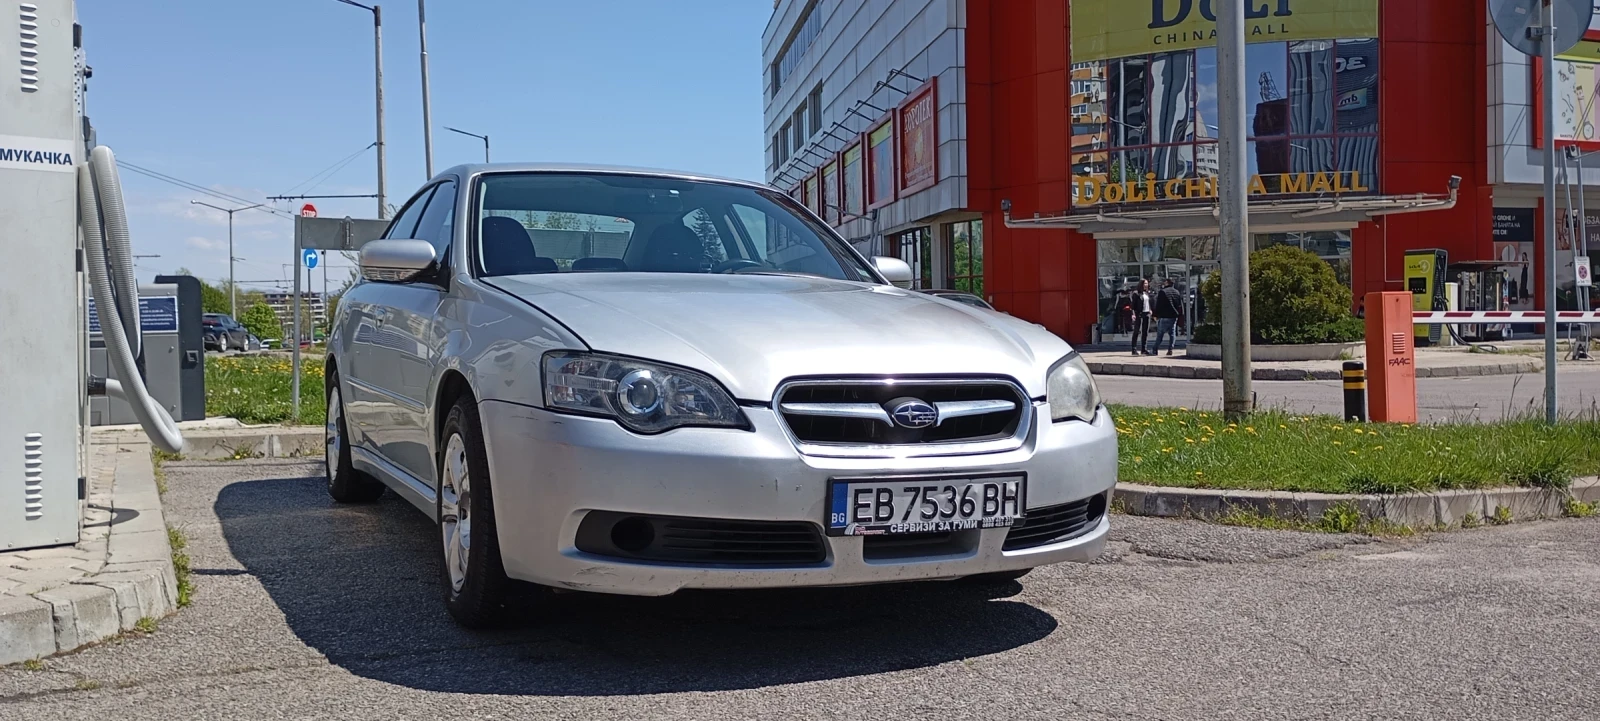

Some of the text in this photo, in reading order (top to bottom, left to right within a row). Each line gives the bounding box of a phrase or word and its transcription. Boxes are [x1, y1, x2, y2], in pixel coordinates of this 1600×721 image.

[1153, 23, 1289, 45] CHINA ALL
[0, 147, 73, 166] МУКАЧКА
[1164, 174, 1268, 200] CHIA
[1280, 170, 1368, 194] MALL
[1389, 357, 1411, 366] FAAC
[853, 481, 1019, 523] EB 7536 BH
[831, 512, 846, 524] BG
[890, 521, 937, 533] СЕРВИЗИ
[937, 521, 951, 531] ЗА
[953, 520, 978, 531] ГУМИ
